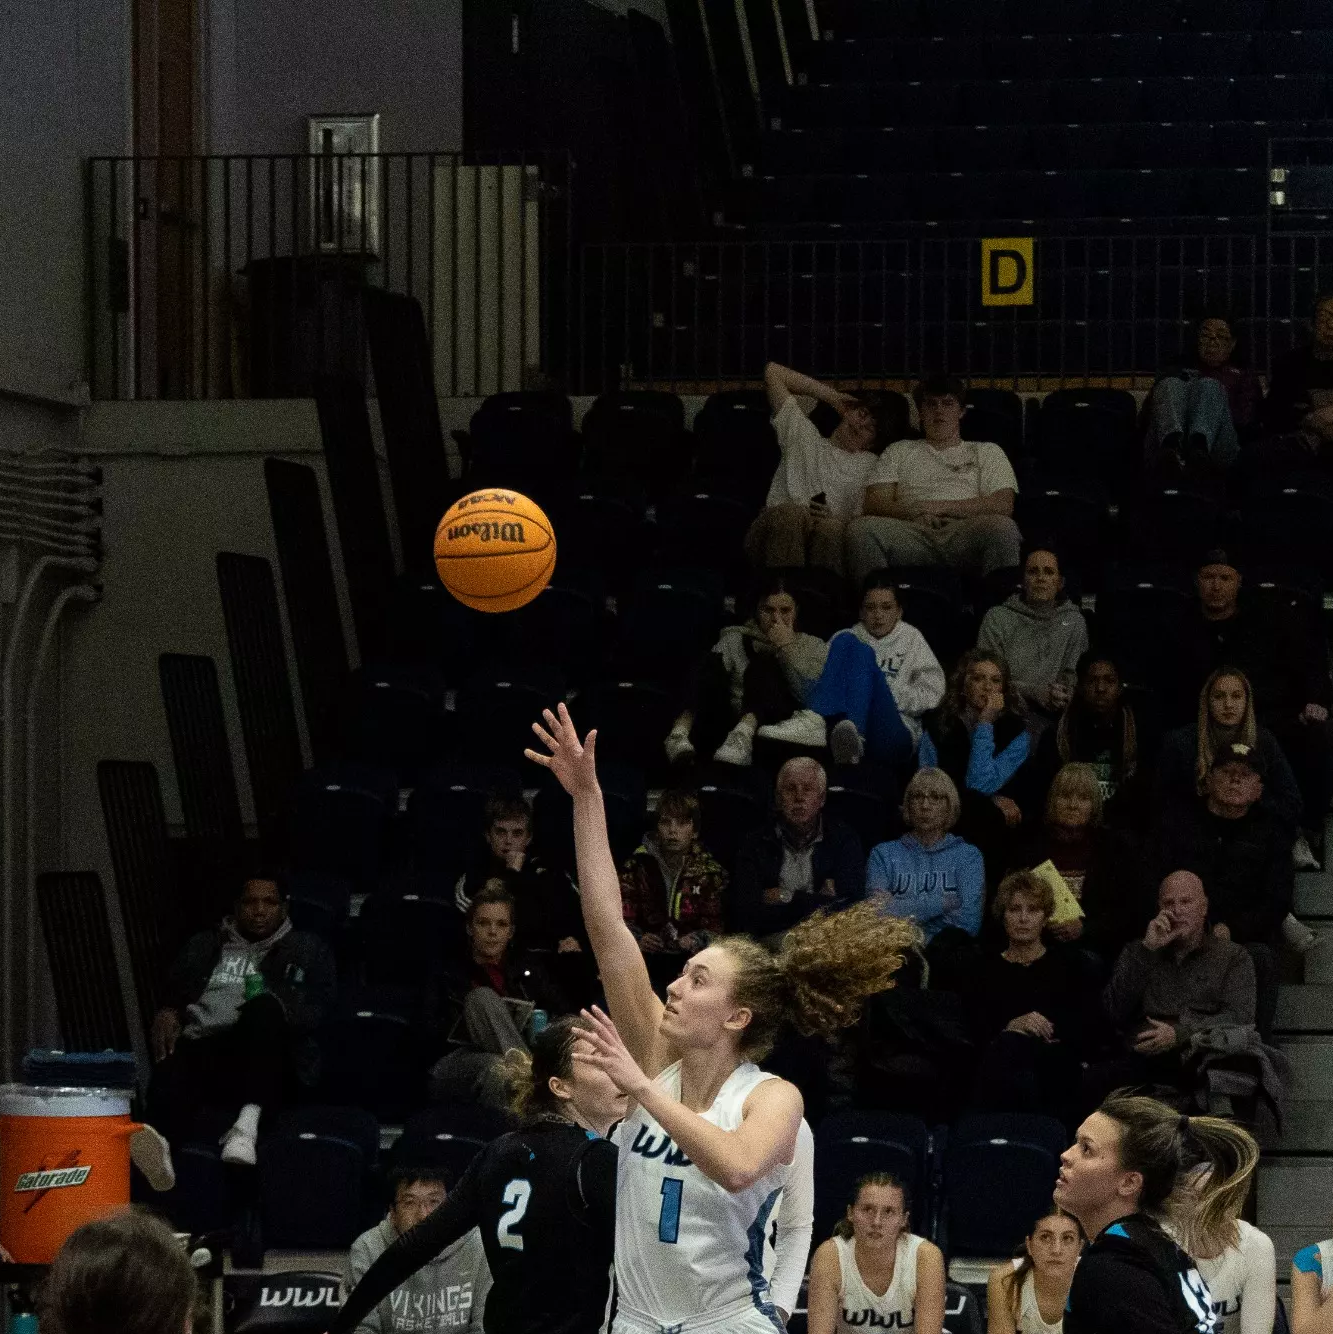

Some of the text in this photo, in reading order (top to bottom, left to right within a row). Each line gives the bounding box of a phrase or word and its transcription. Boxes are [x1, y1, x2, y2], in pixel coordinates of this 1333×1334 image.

[990, 250, 1026, 294] D
[448, 521, 525, 543] Wilson
[16, 1168, 89, 1191] Gatorade
[496, 1177, 533, 1252] 2
[658, 1176, 684, 1245] 1
[390, 1282, 473, 1318] VIKINGS
[842, 1308, 916, 1330] WWU
